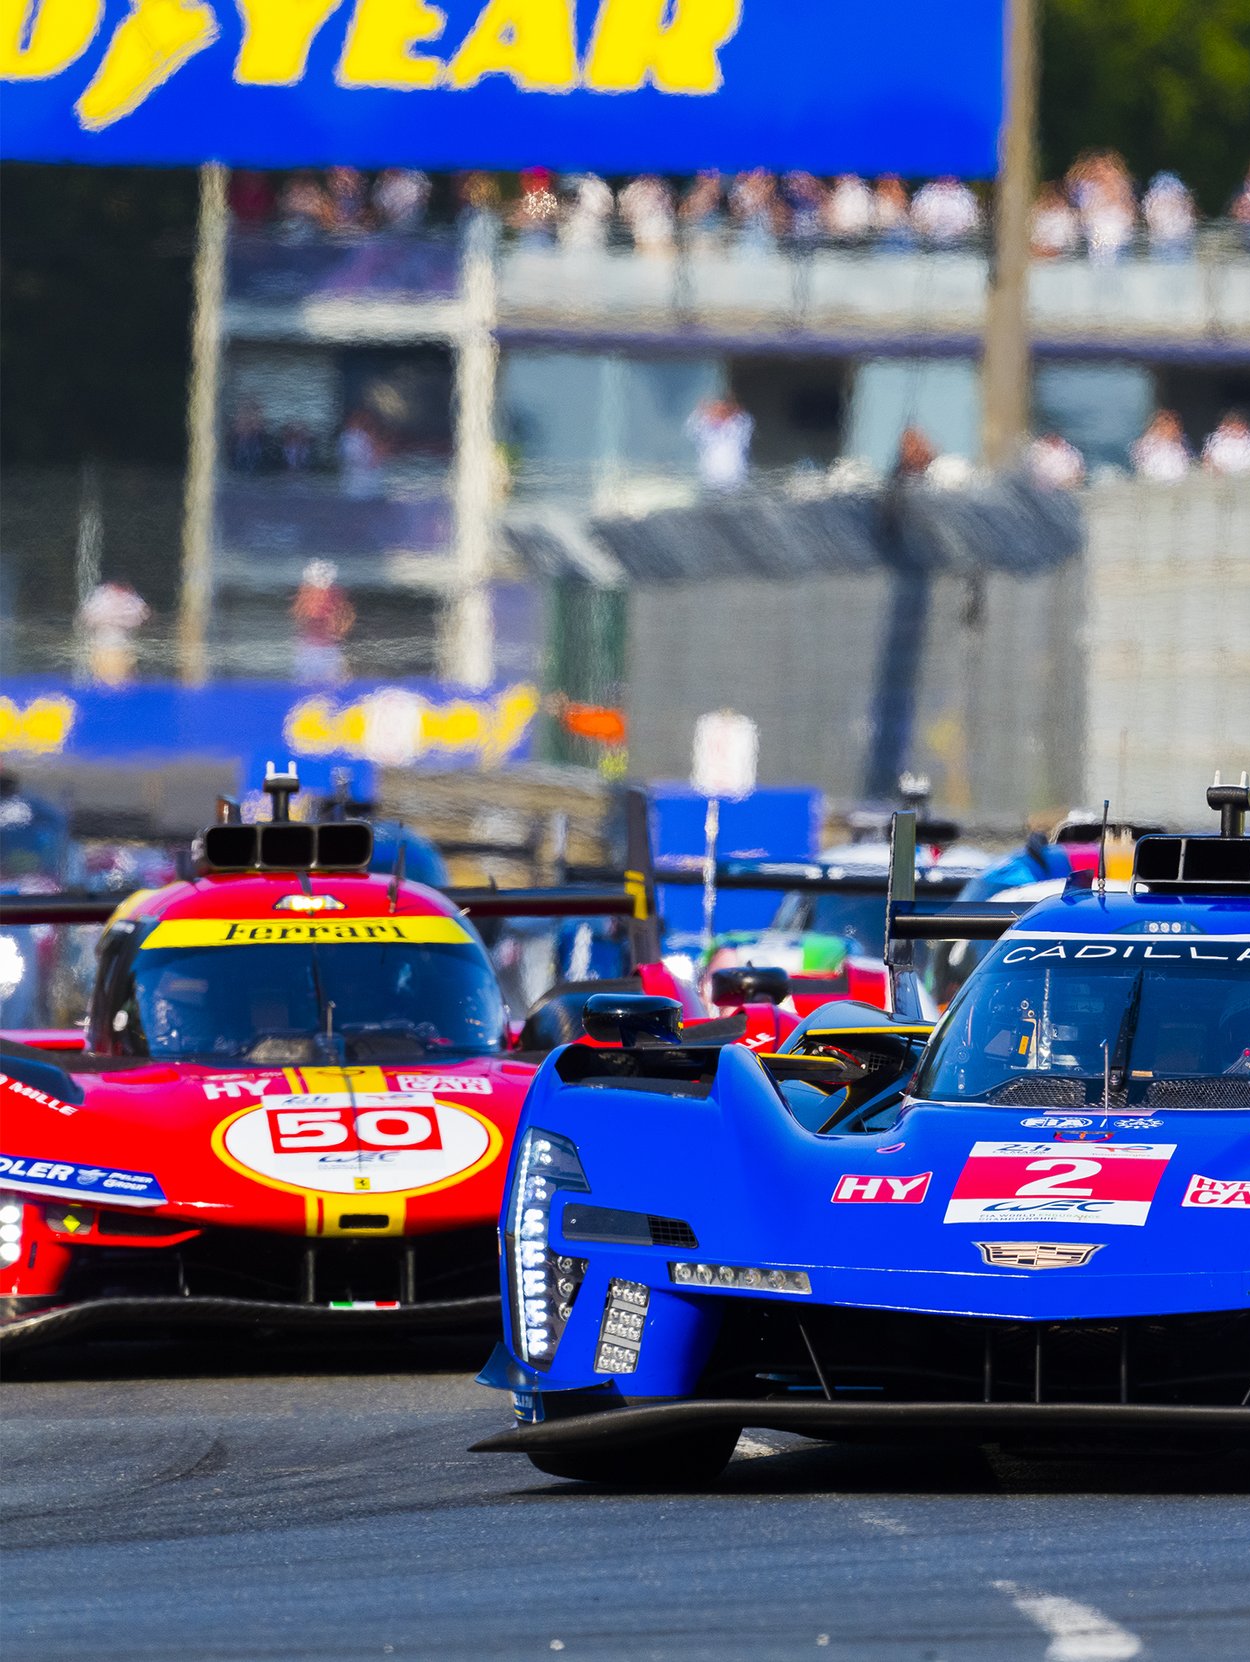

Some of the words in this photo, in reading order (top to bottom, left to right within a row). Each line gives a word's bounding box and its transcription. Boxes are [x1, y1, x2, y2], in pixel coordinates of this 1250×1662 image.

[224, 918, 408, 941] Ferrari
[201, 1079, 271, 1100] HY
[405, 1081, 485, 1091] CAR
[8, 1080, 78, 1117] MILLE
[276, 1110, 432, 1148] 50
[837, 1176, 928, 1200] HY
[1014, 1158, 1103, 1197] 2
[982, 1200, 1115, 1212] WEC
